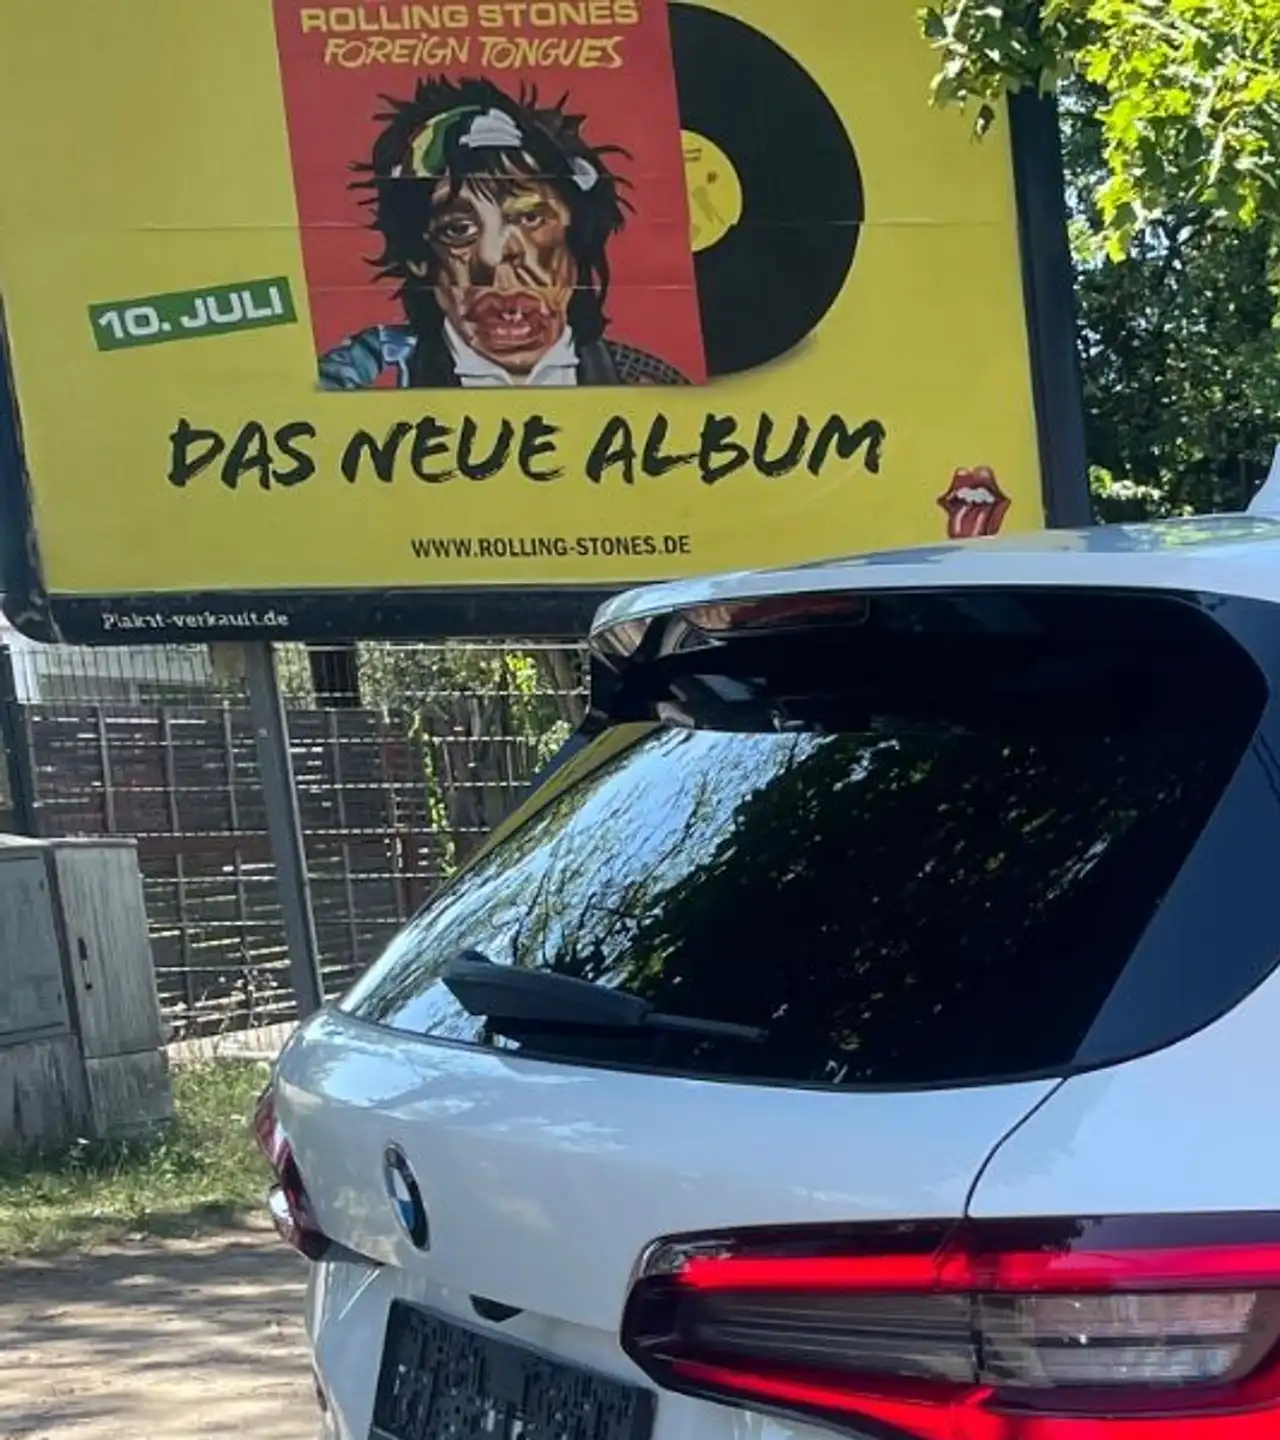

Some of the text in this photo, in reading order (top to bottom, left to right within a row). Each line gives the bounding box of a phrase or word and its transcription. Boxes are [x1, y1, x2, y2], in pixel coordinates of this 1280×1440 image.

[300, 0, 640, 33] ROLLING STONES
[324, 32, 624, 68] FOREIGN TONGUES
[98, 286, 284, 339] 10. JULI
[167, 412, 886, 491] DAS NEUE ALBUM
[410, 535, 692, 558] WWW.ROLLING-STONES.DE
